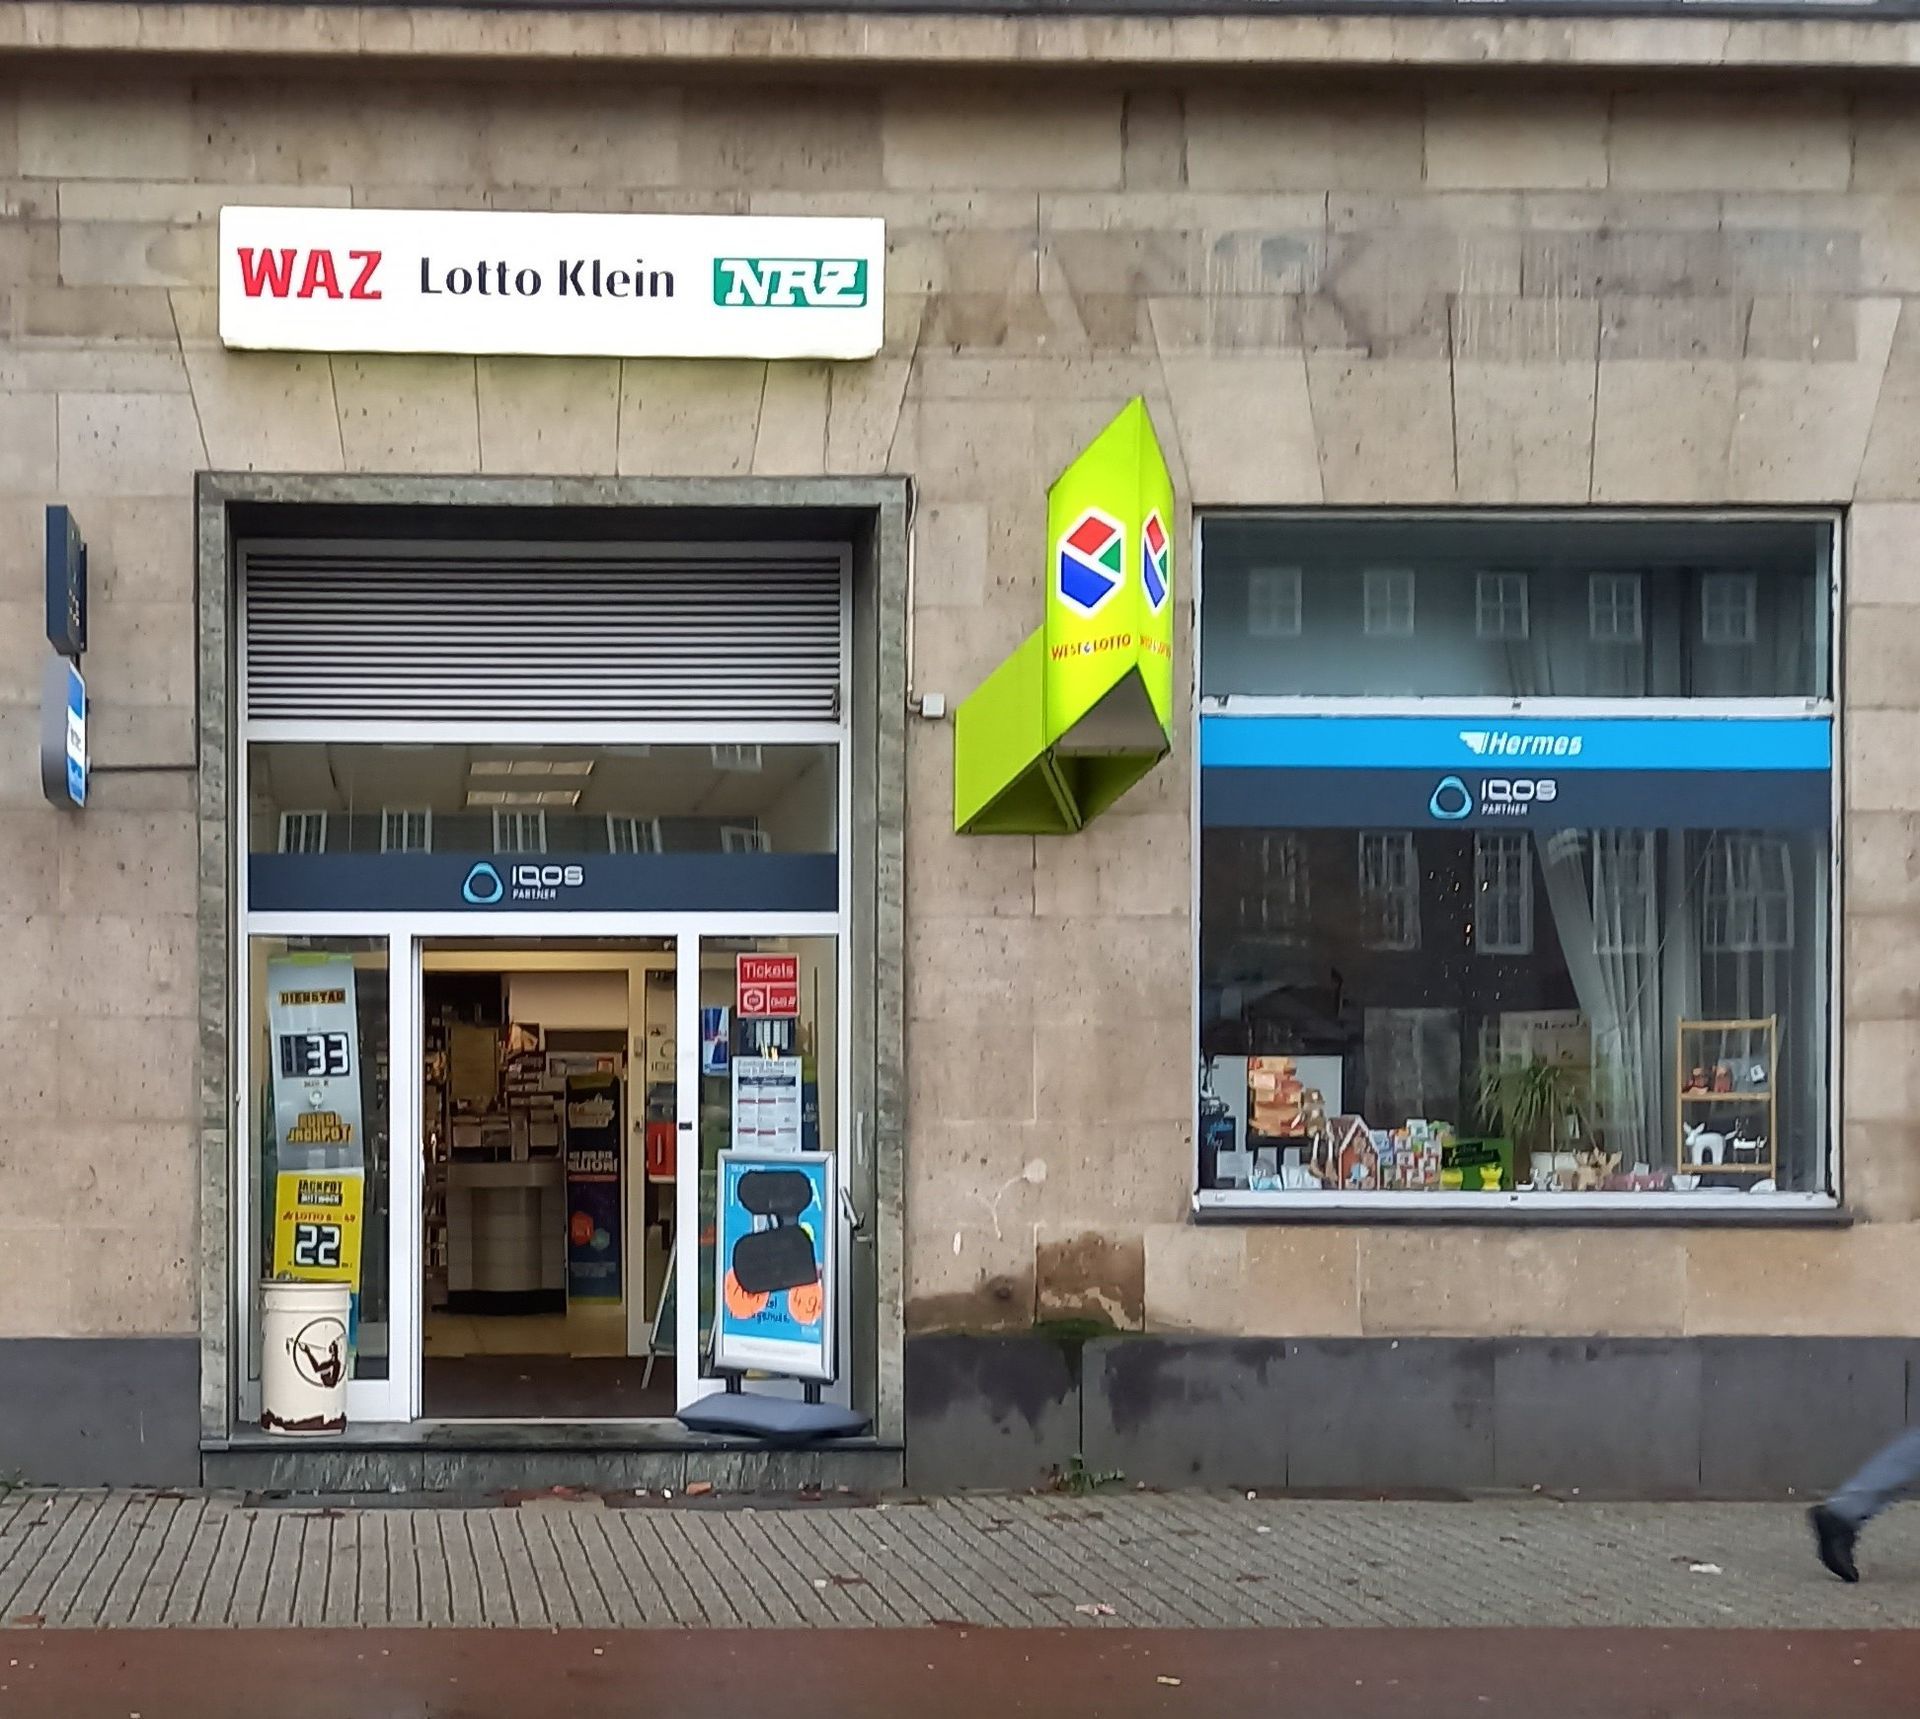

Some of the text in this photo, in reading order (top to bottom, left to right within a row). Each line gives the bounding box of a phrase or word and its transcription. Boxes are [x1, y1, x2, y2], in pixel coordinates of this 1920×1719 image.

[237, 247, 382, 299] WAZ
[421, 257, 675, 298] Lotto Klein
[720, 259, 860, 306] NRZ
[1488, 731, 1583, 756] Hermes
[1481, 778, 1557, 803] IQOS
[1481, 803, 1529, 816] PARTNER
[512, 865, 584, 888] IQOS
[512, 888, 557, 900] PARTNER
[743, 961, 794, 979] Tickets
[295, 1224, 340, 1266] 22
